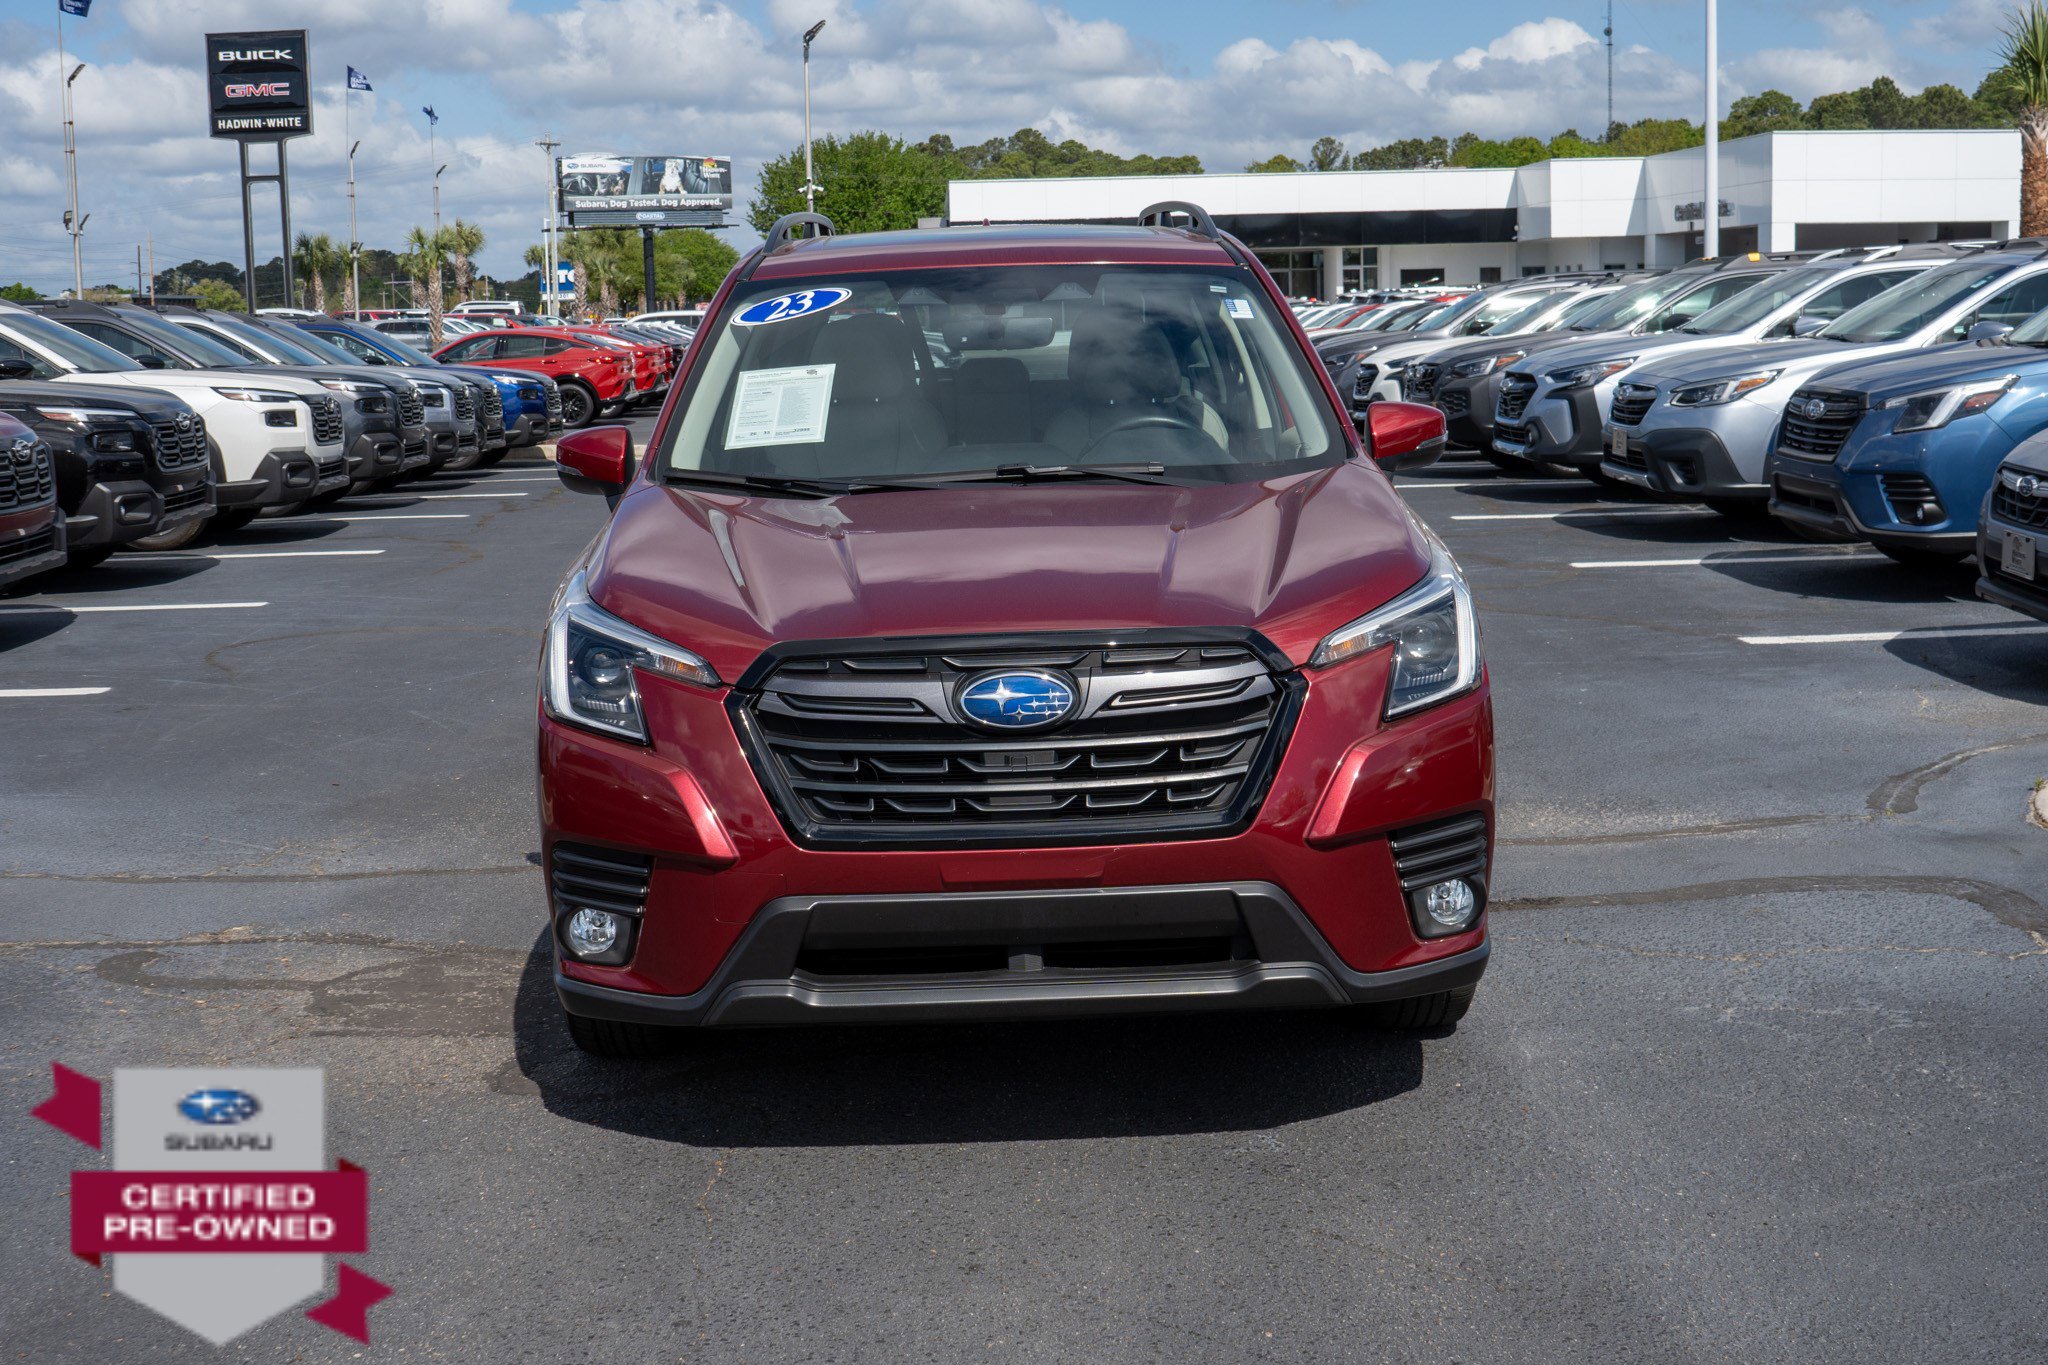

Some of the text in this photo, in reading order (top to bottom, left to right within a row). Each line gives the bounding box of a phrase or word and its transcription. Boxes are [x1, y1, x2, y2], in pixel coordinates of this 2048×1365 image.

[218, 49, 294, 62] BUICK
[225, 82, 290, 98] GMC
[218, 117, 302, 130] HADWIN-WHITE
[575, 198, 723, 209] Subaru, Dog Tested. Dog Approved.
[764, 291, 815, 322] 23
